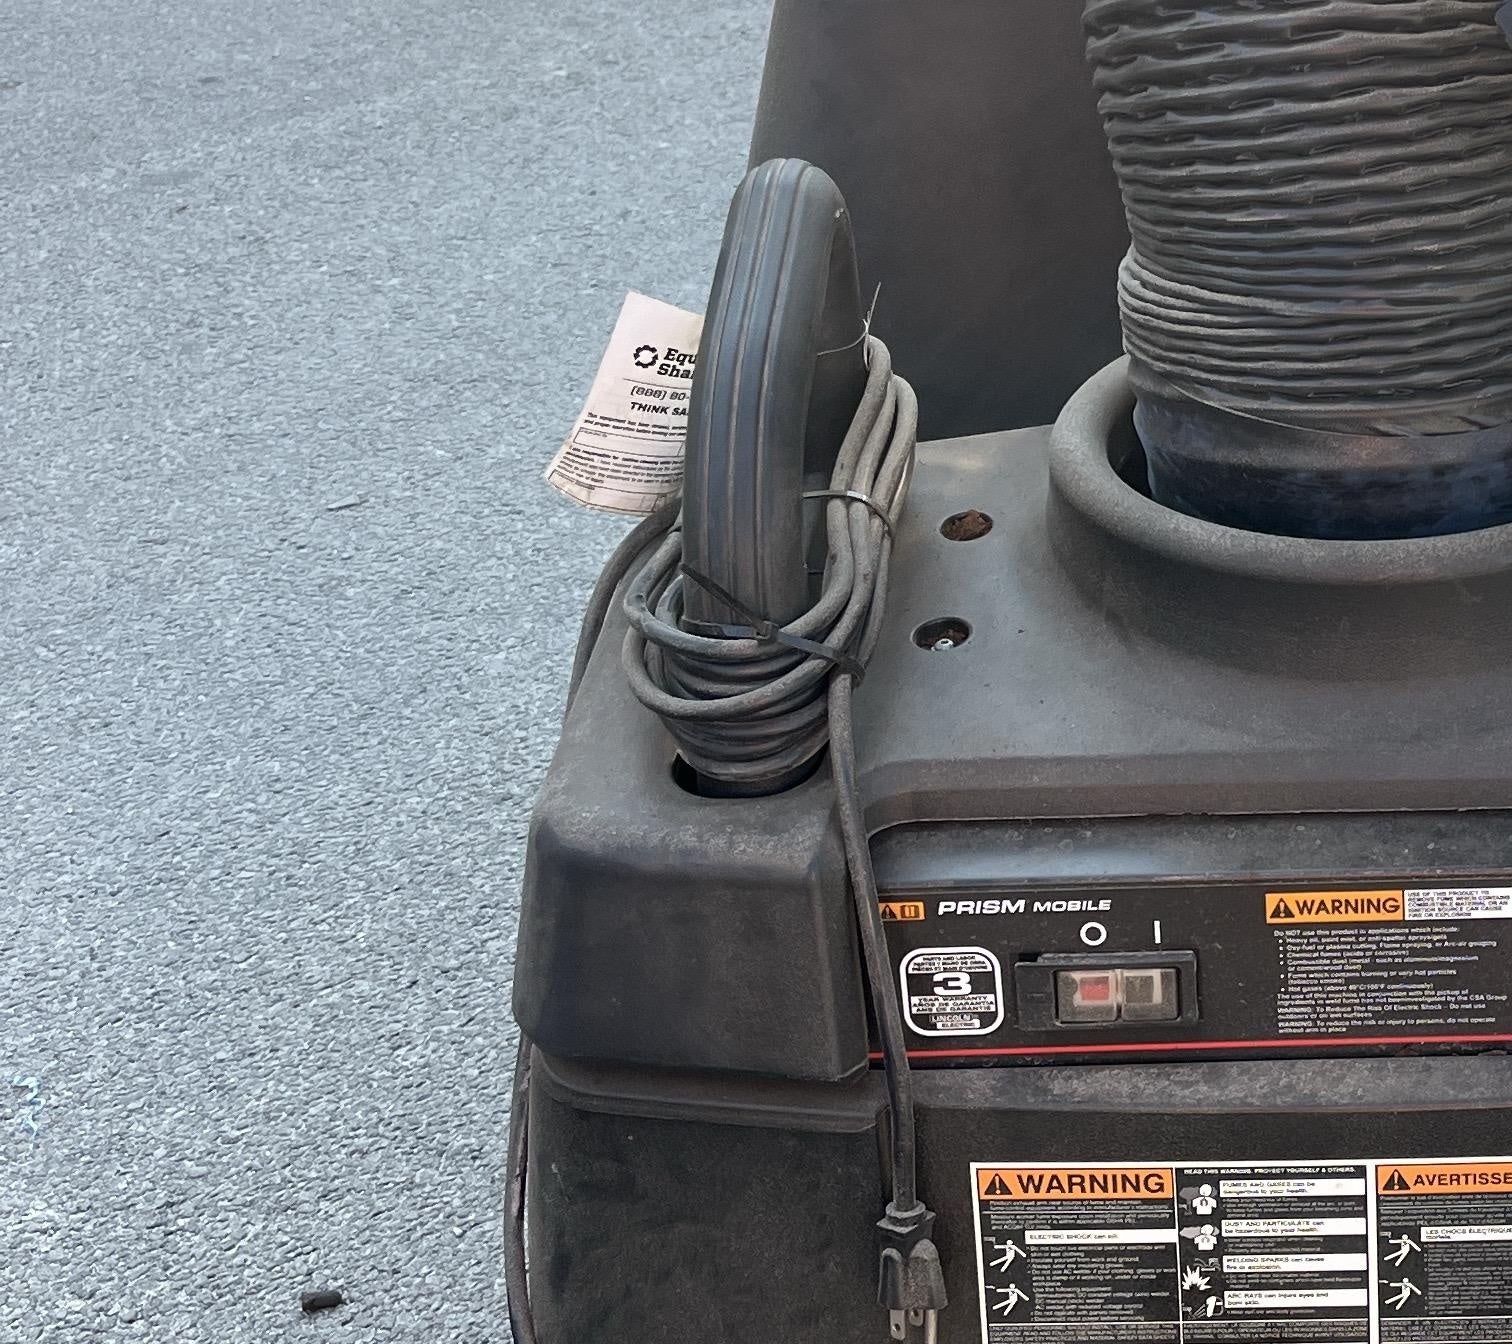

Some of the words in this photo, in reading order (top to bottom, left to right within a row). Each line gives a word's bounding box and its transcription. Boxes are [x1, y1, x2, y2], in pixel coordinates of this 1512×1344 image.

[664, 347, 697, 366] Equ
[631, 401, 669, 414] THINK
[672, 407, 688, 416] SA
[938, 899, 1026, 916] PRISM
[1033, 899, 1112, 912] MOBILE
[1295, 897, 1400, 916] WARNING
[933, 971, 972, 996] 3
[1017, 1173, 1166, 1194] WARNING
